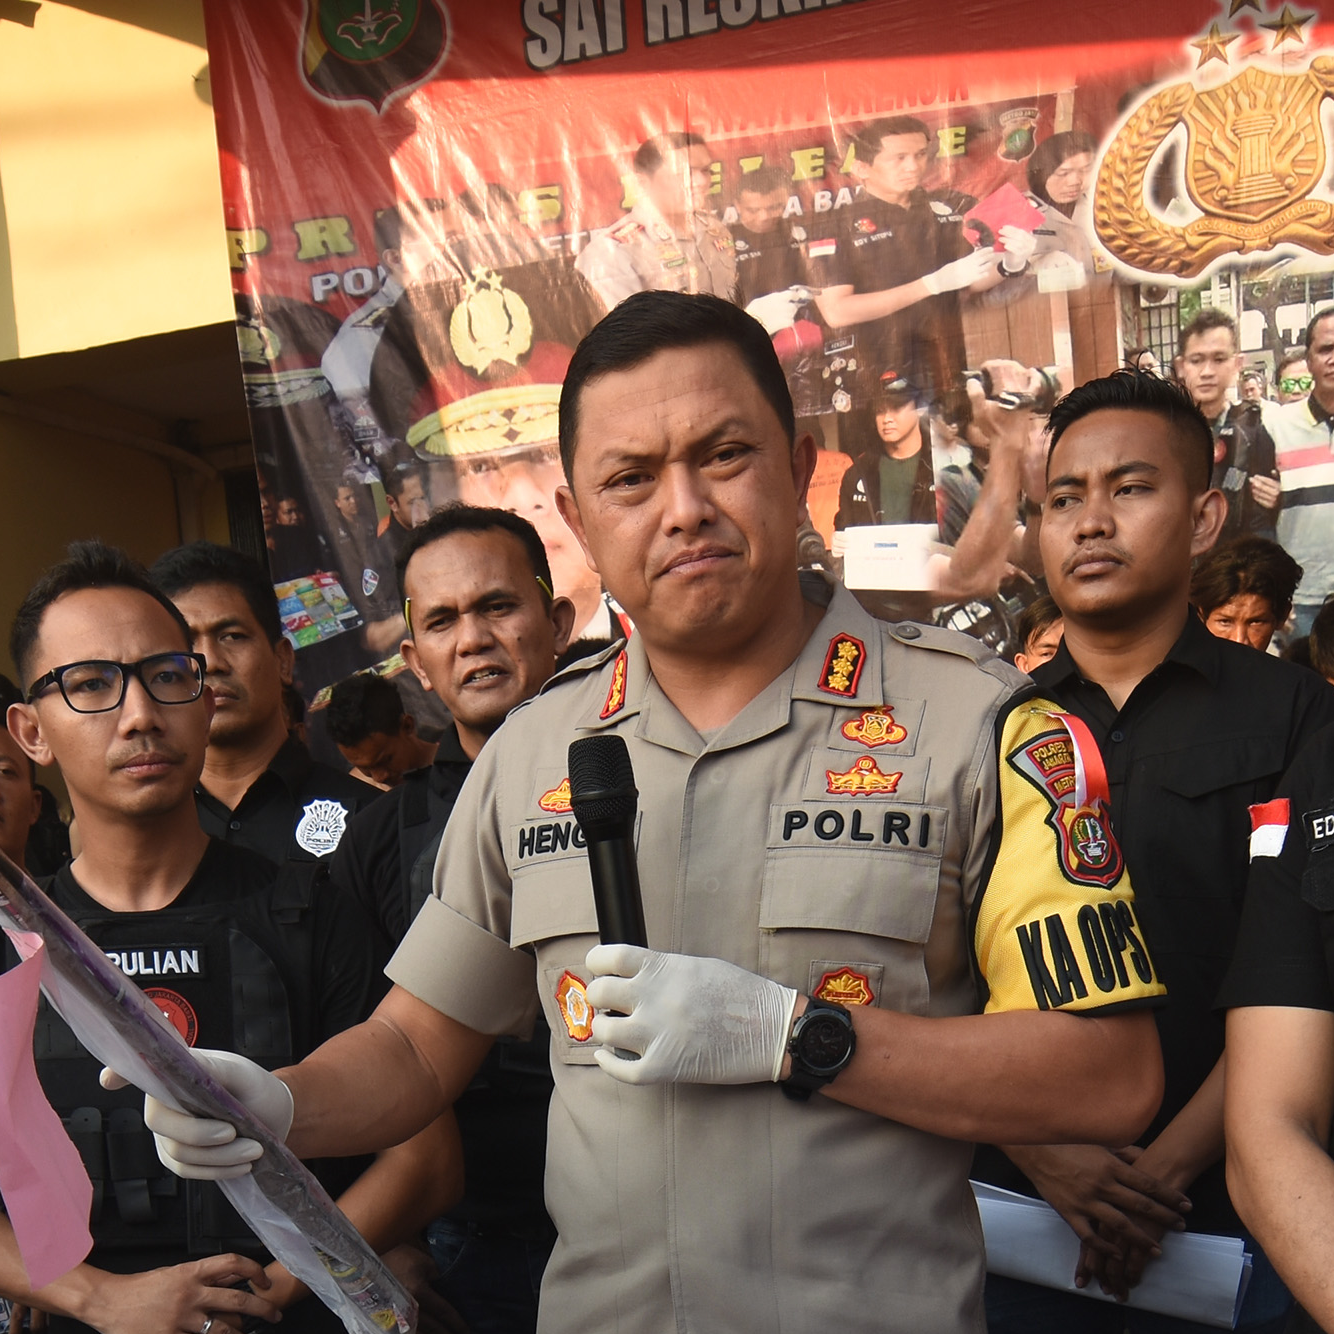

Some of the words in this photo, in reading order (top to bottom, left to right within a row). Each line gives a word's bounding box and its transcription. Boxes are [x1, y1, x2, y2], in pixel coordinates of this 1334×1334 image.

[1054, 775, 1076, 793] METR
[518, 820, 589, 859] HENG
[783, 810, 932, 849] POLRI
[1015, 918, 1084, 1011] KA
[1078, 900, 1156, 990] OPS
